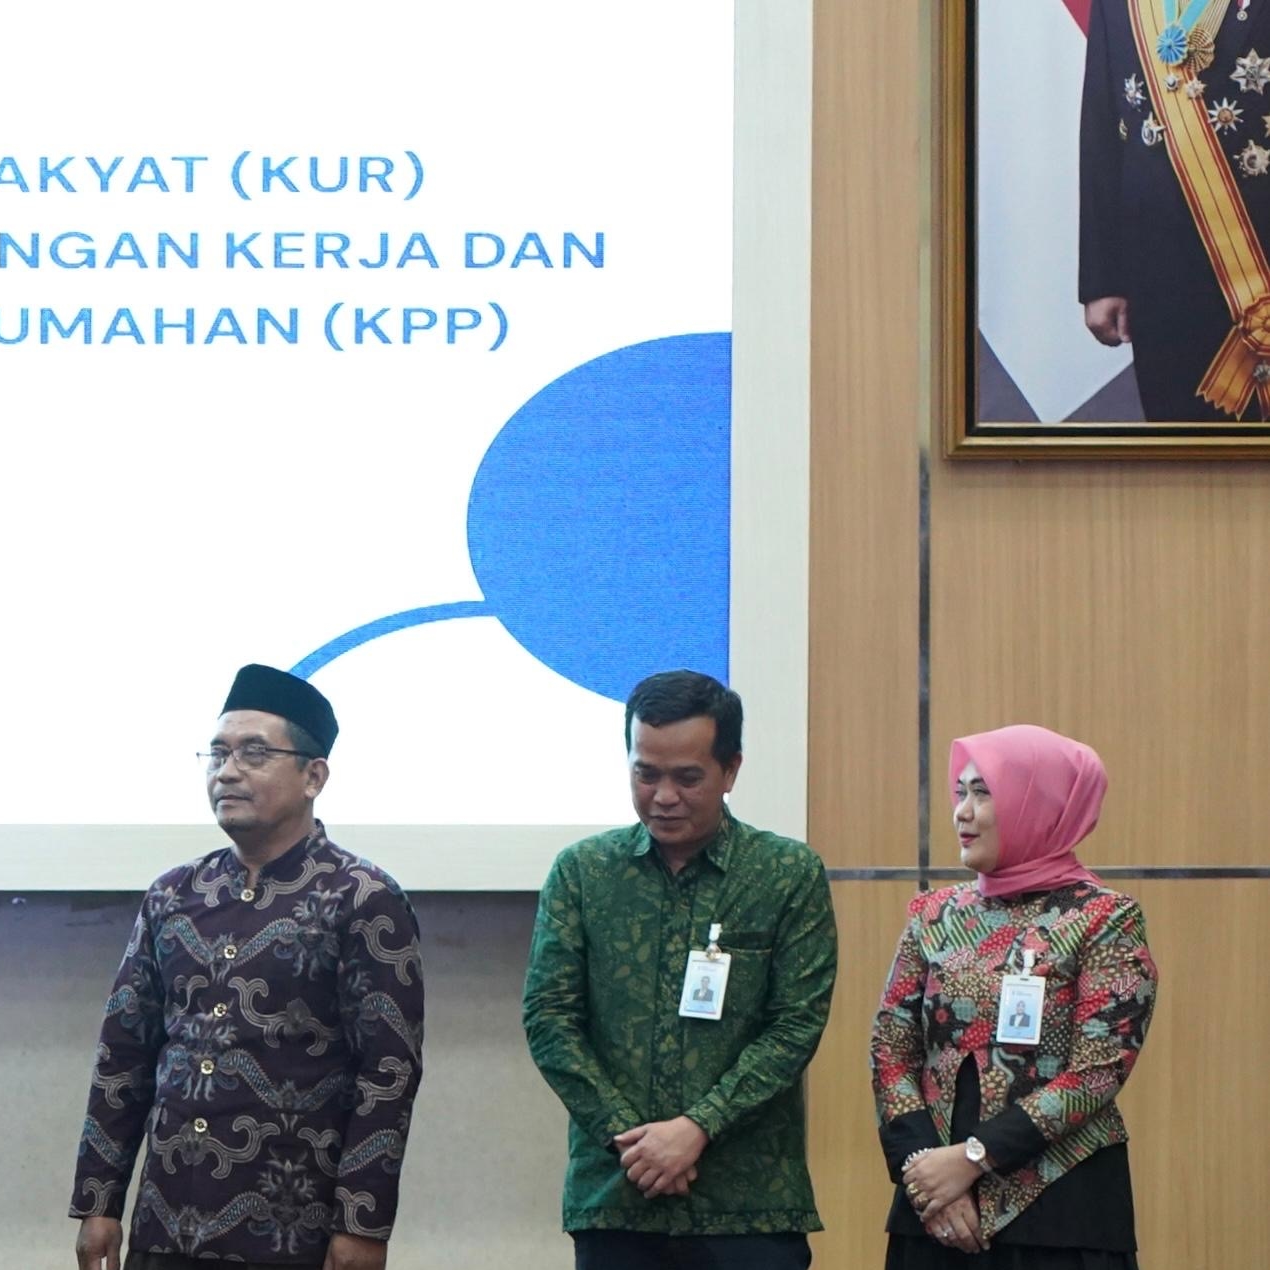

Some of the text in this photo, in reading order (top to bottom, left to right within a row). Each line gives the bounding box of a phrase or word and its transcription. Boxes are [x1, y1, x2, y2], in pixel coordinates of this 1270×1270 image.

[229, 150, 426, 201] (KUR)
[224, 230, 441, 270] KERJA
[463, 230, 606, 270] DAN
[322, 300, 510, 352] (KPP)
